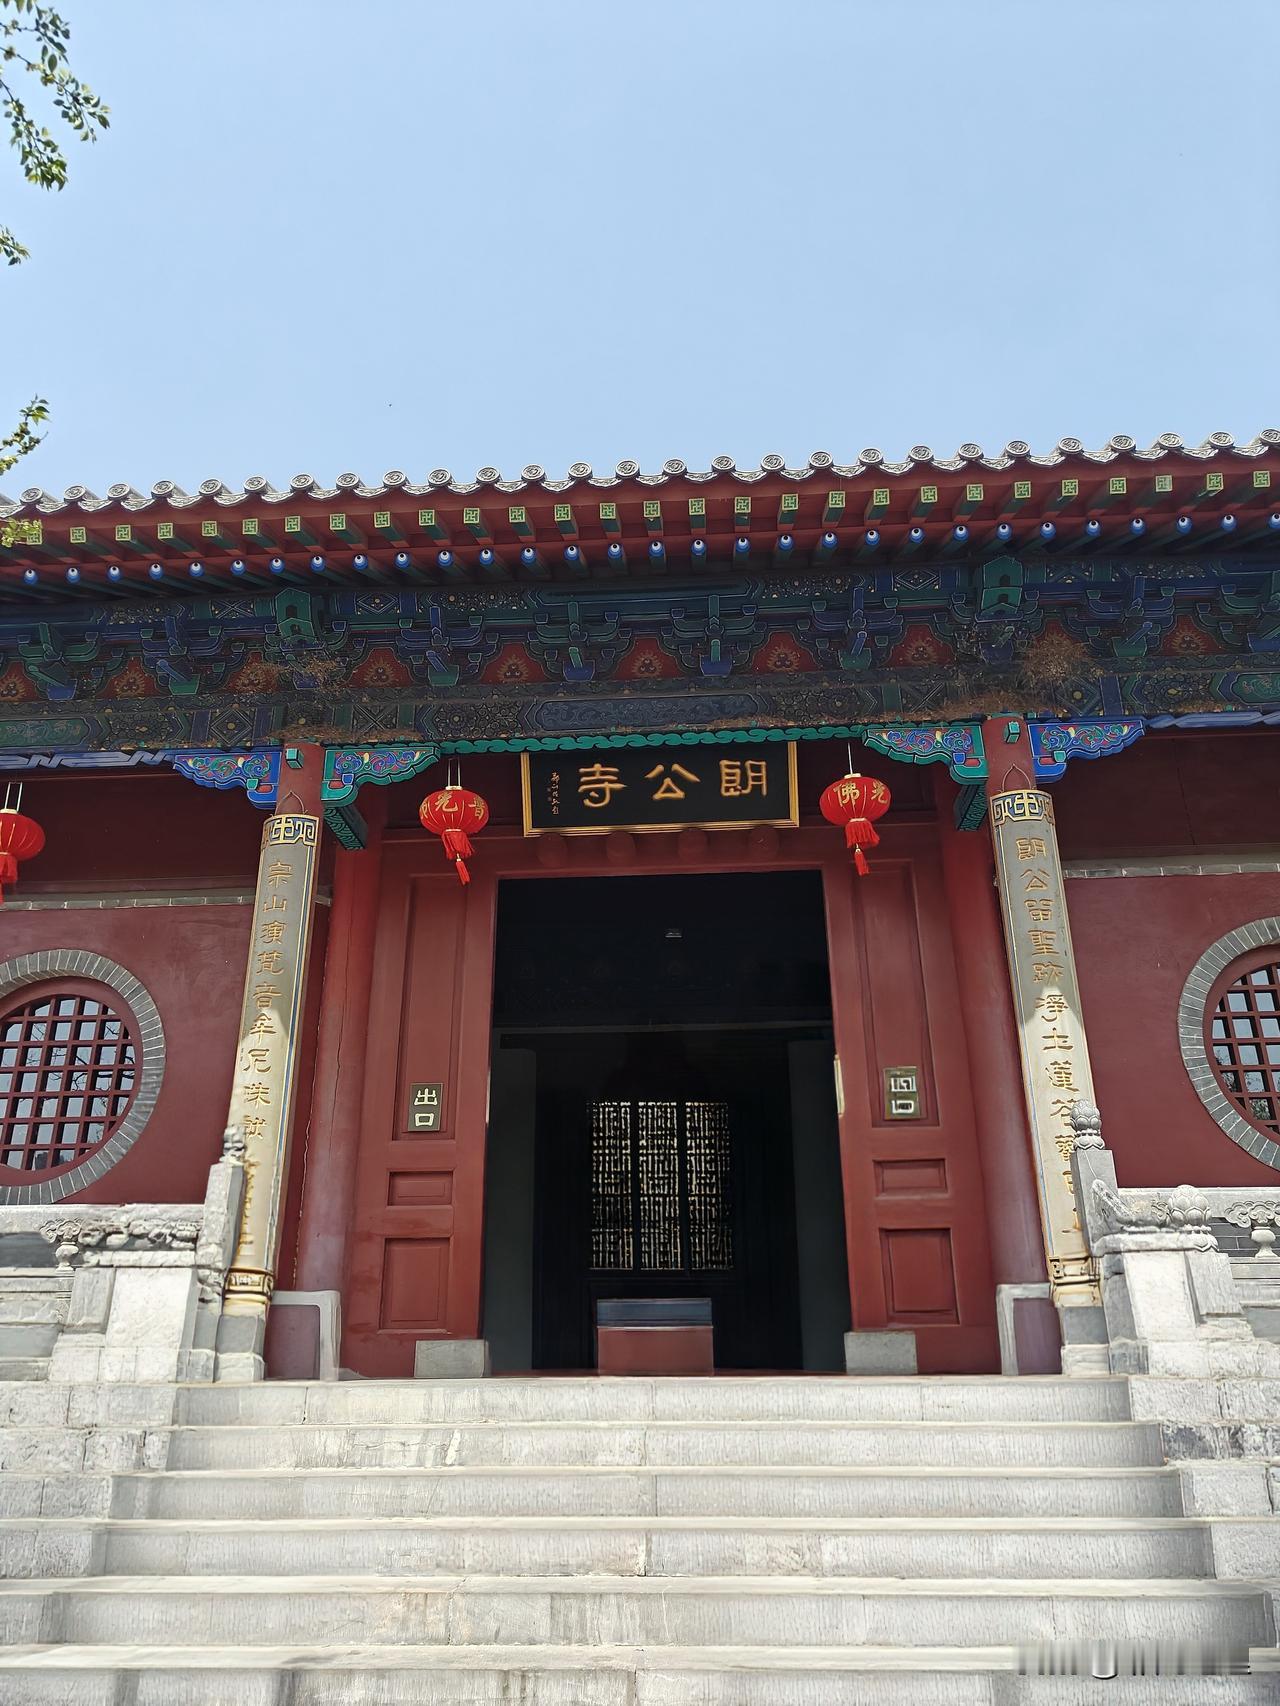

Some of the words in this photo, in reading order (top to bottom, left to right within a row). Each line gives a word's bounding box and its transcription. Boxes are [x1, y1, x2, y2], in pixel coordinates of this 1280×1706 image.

[578, 758, 768, 808] 朗公寺
[414, 1088, 438, 1127] 出口
